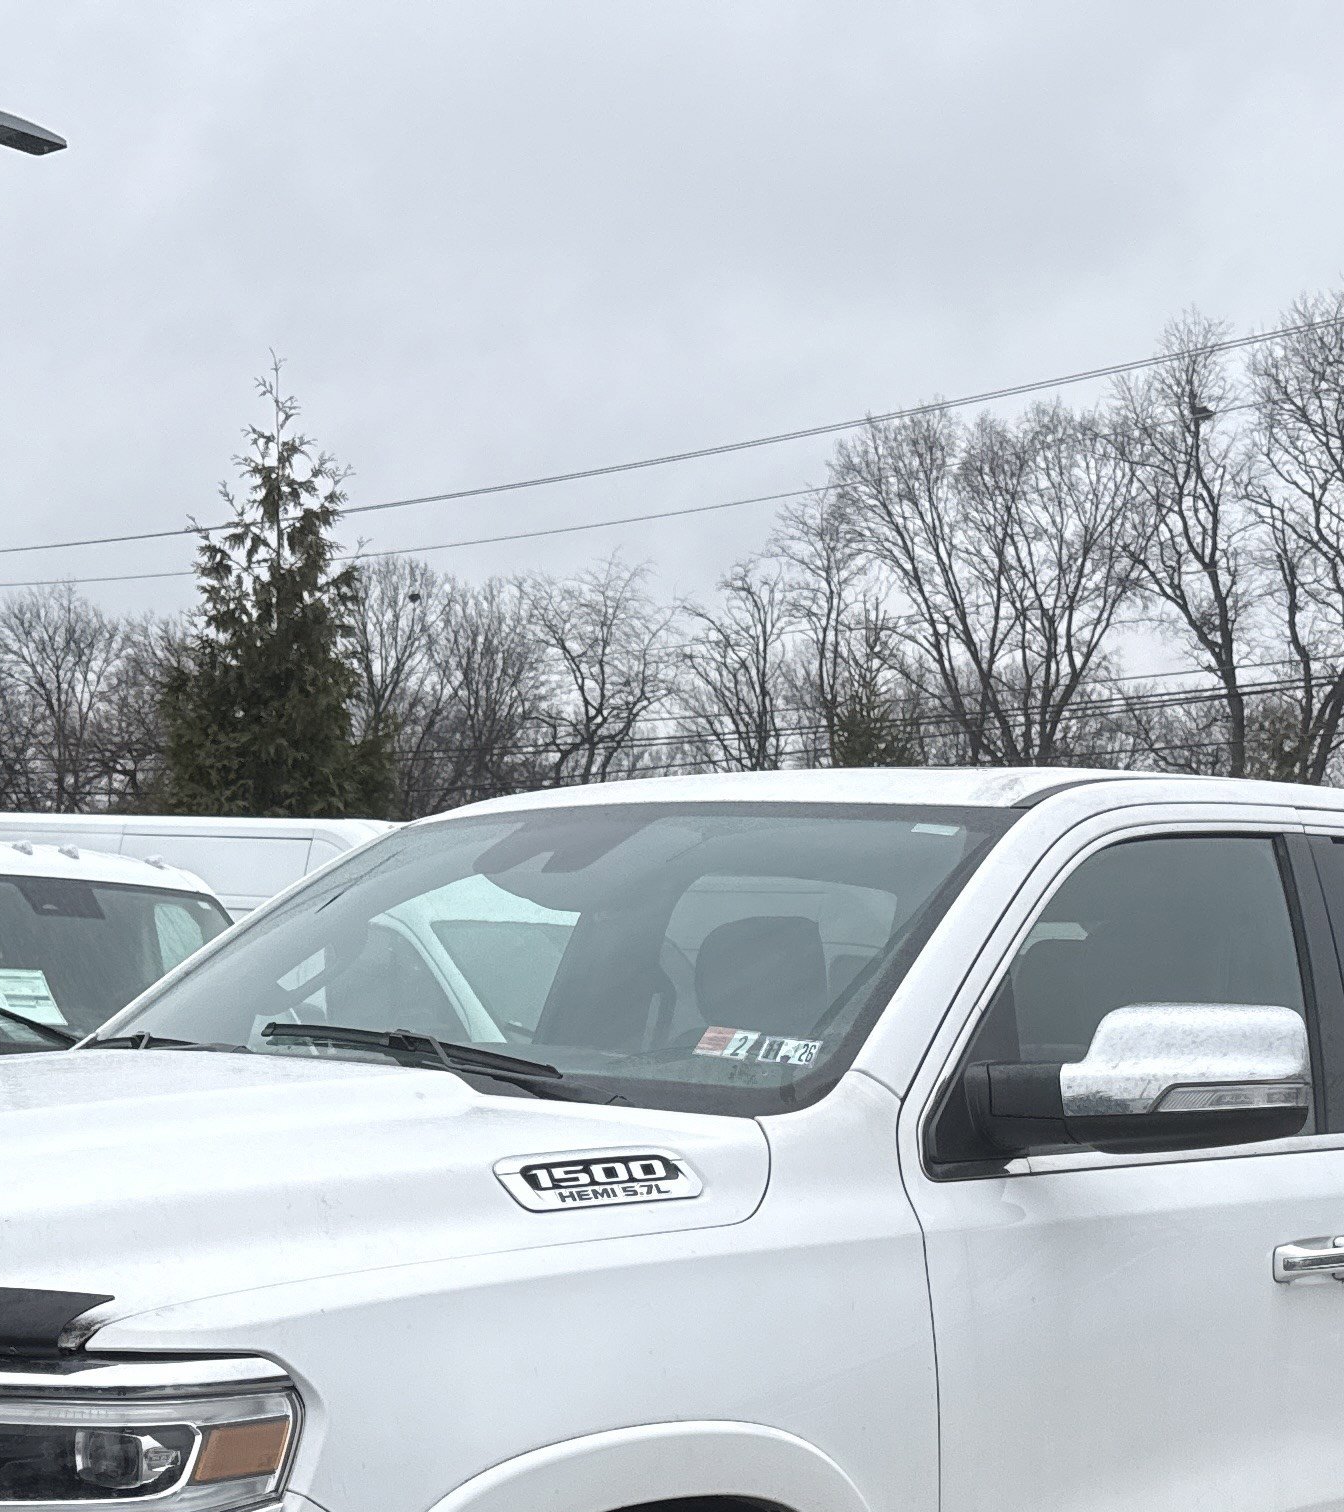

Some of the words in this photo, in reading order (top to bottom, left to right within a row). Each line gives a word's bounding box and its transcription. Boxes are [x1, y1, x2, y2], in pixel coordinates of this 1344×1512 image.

[729, 1035, 749, 1057] 2
[797, 1043, 817, 1063] 26
[527, 1159, 667, 1189] 1500
[557, 1186, 618, 1203] HEMI
[621, 1183, 671, 1198] 5.7L
